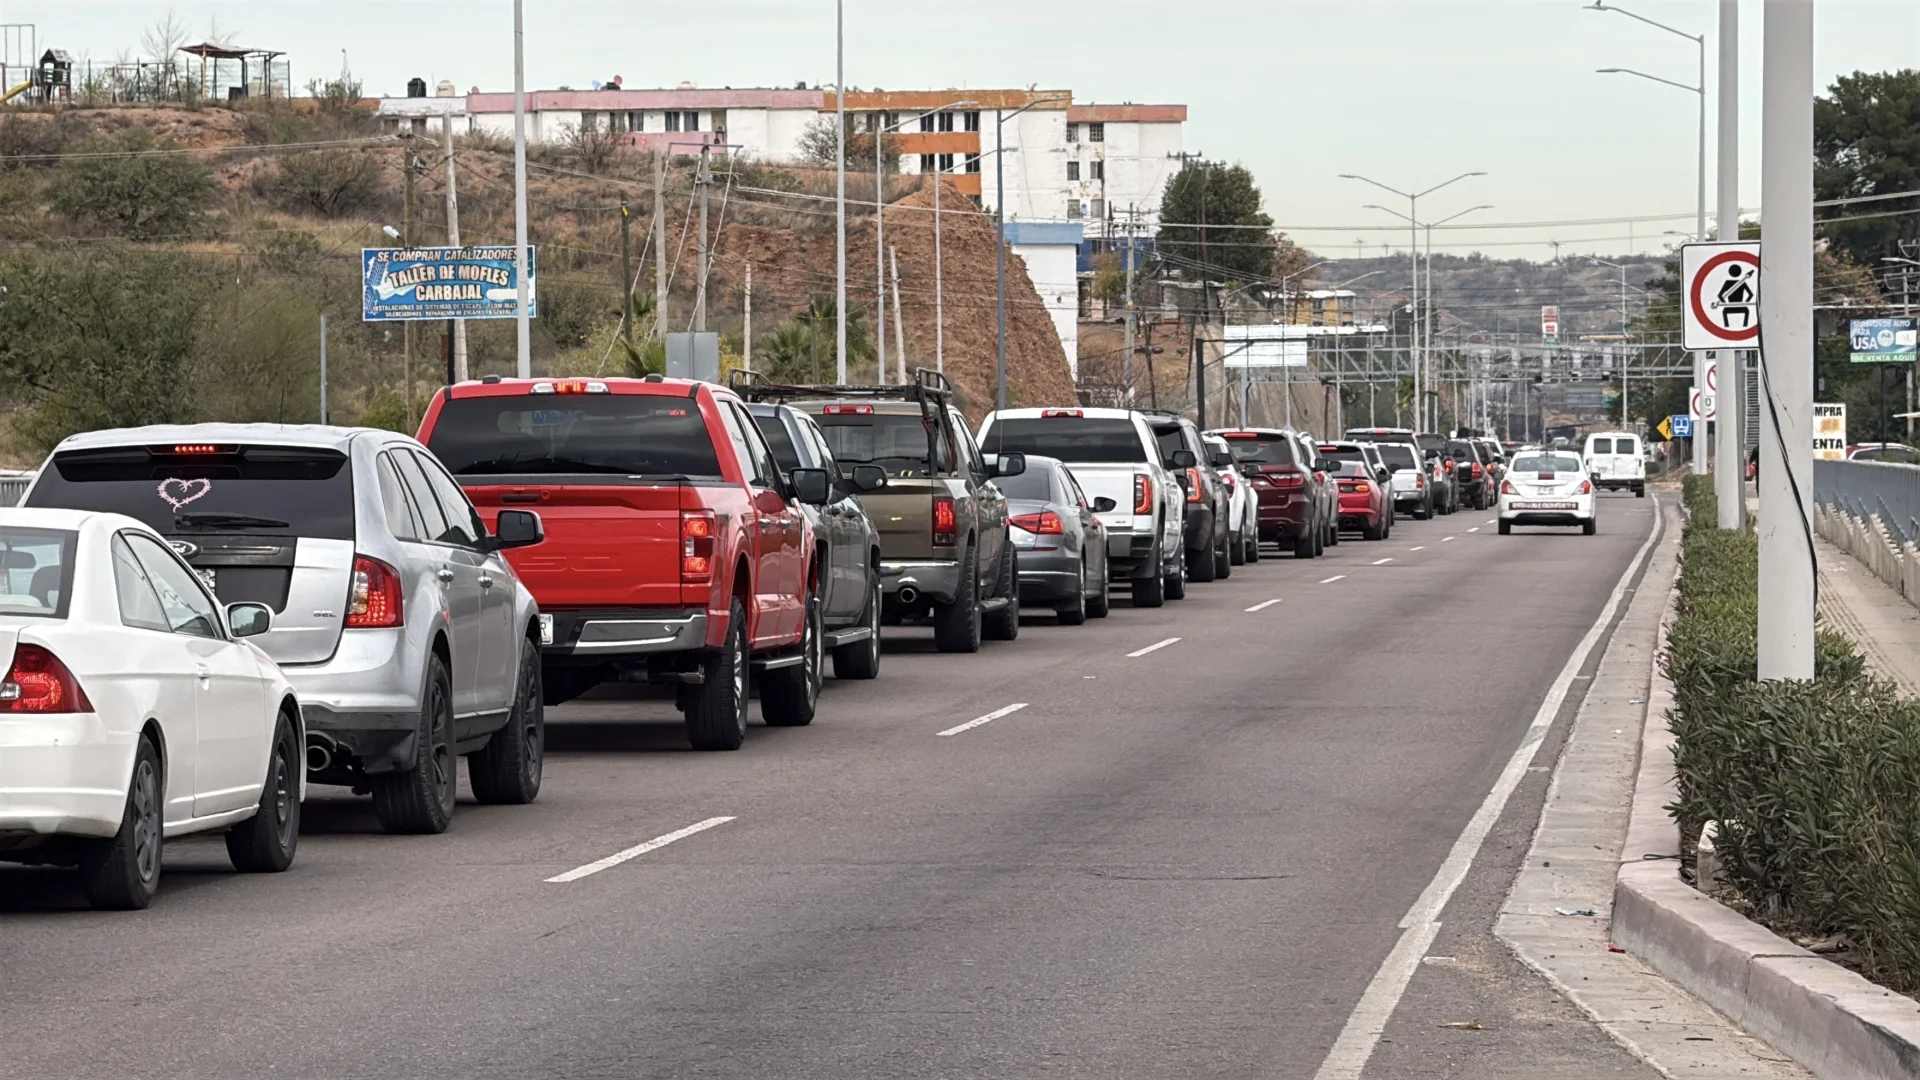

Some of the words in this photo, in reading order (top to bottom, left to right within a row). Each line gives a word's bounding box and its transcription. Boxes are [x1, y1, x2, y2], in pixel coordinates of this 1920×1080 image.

[377, 251, 390, 263] SE
[392, 250, 441, 262] COMPRAN
[389, 265, 437, 288] TALLER
[438, 264, 455, 281] DE
[457, 263, 510, 287] MOFLES
[415, 284, 483, 301] CARBAJAL
[1893, 319, 1911, 327] AUTO
[1853, 328, 1870, 336] PARA
[1852, 336, 1879, 350] USA
[1813, 406, 1842, 417] MPRA
[1813, 438, 1844, 450] ENTA
